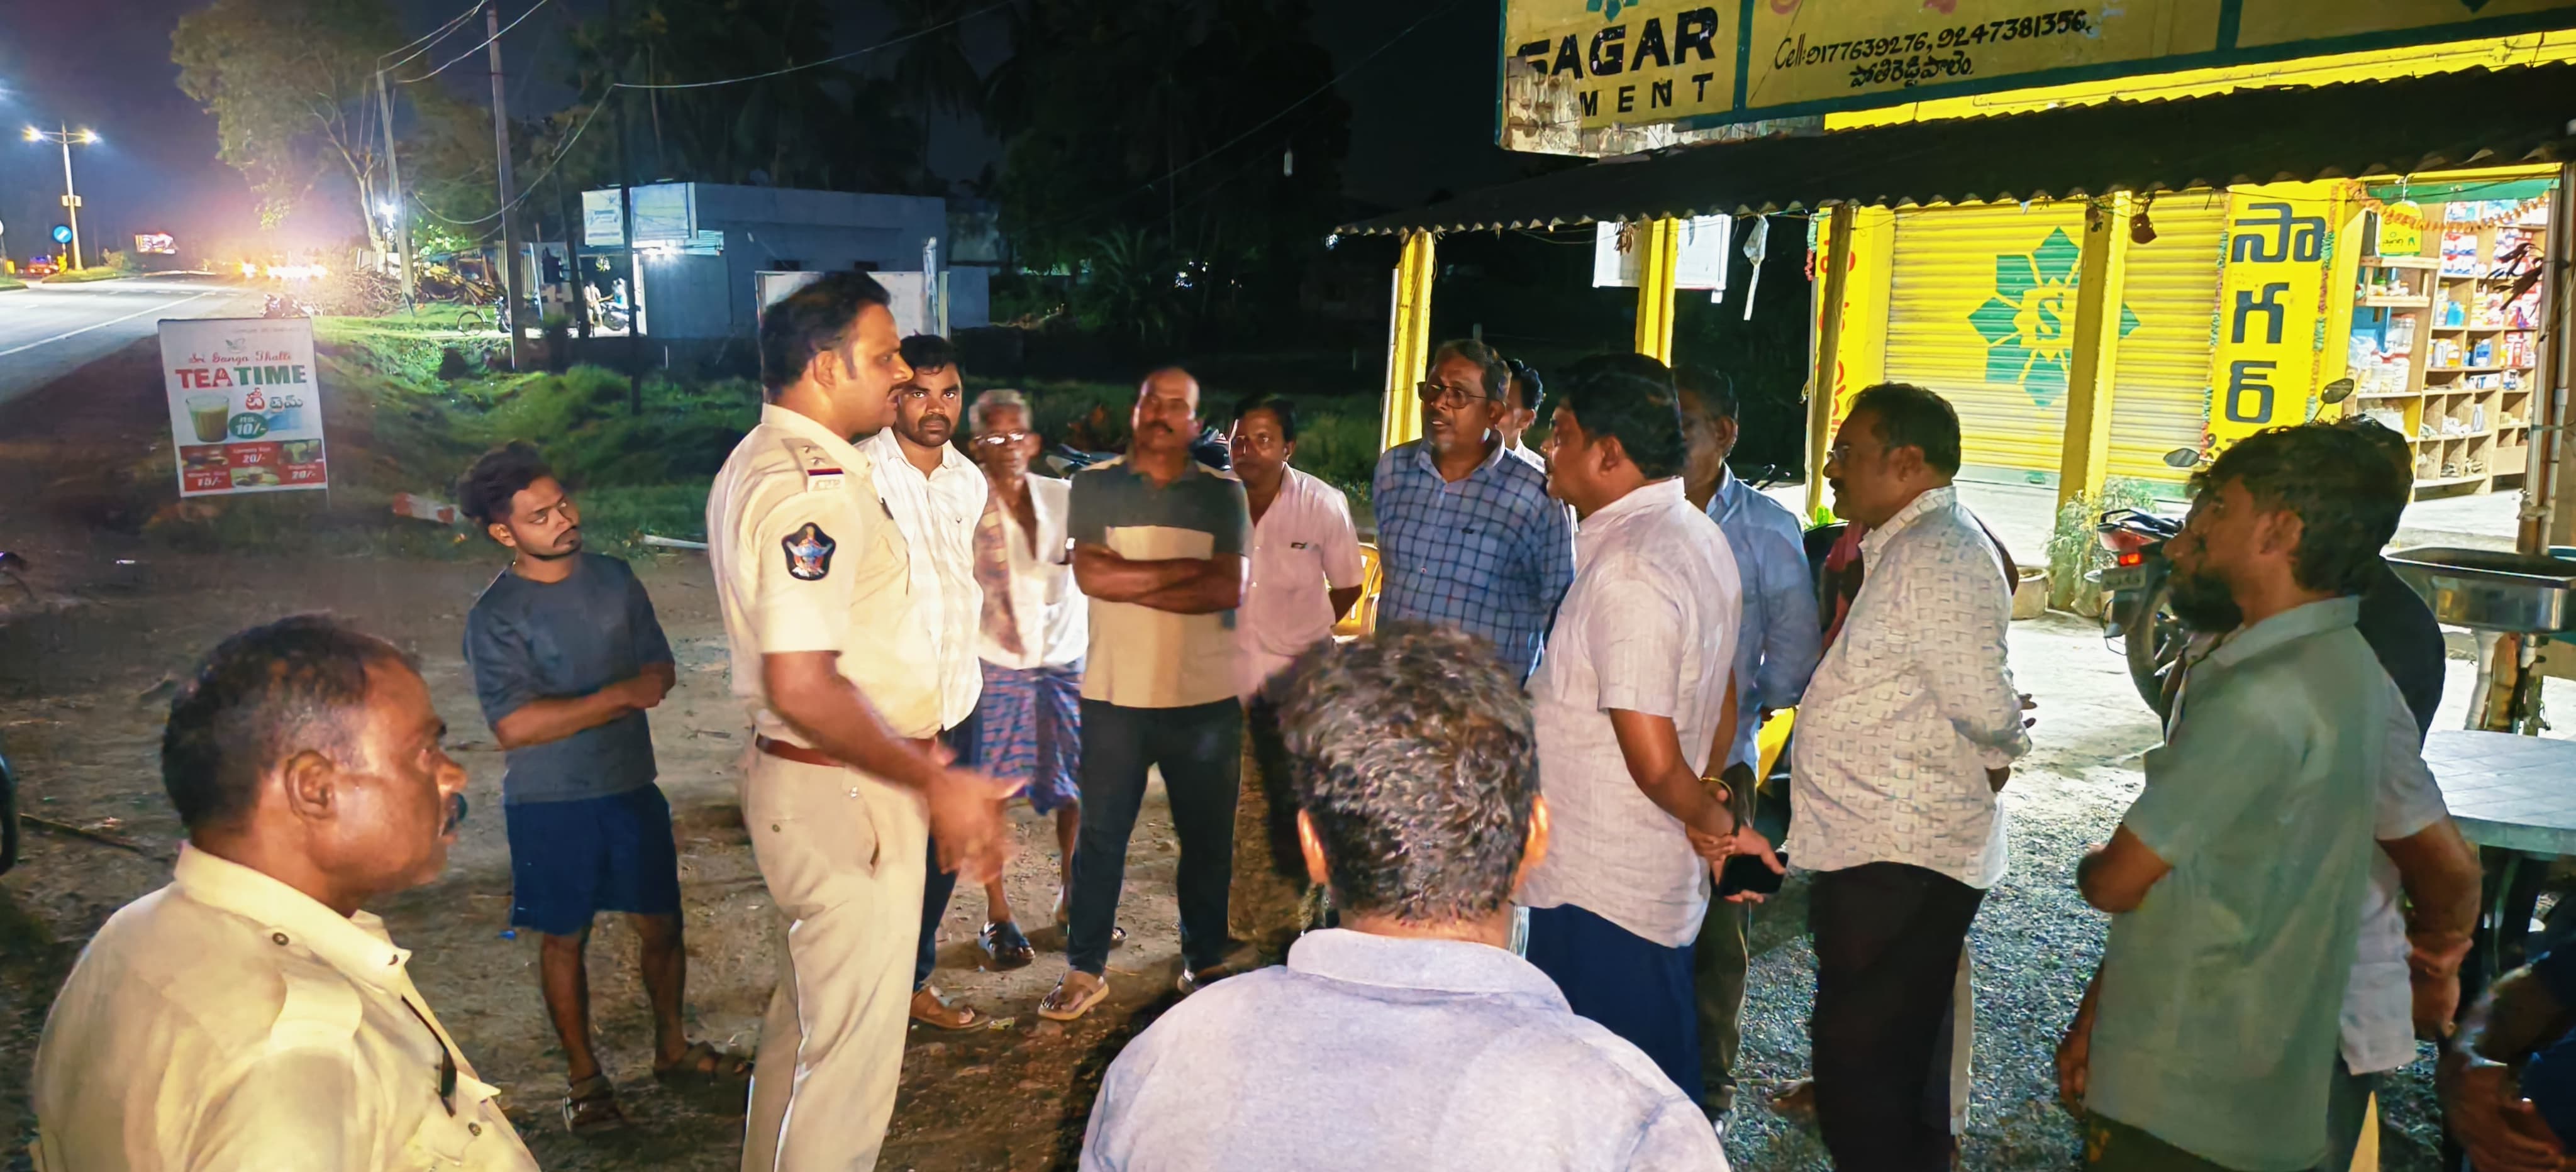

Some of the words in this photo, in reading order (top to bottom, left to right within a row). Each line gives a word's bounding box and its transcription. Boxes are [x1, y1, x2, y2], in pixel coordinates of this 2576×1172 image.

[175, 368, 233, 390] TEA
[233, 365, 308, 386] TIME
[235, 423, 267, 435] 10/-
